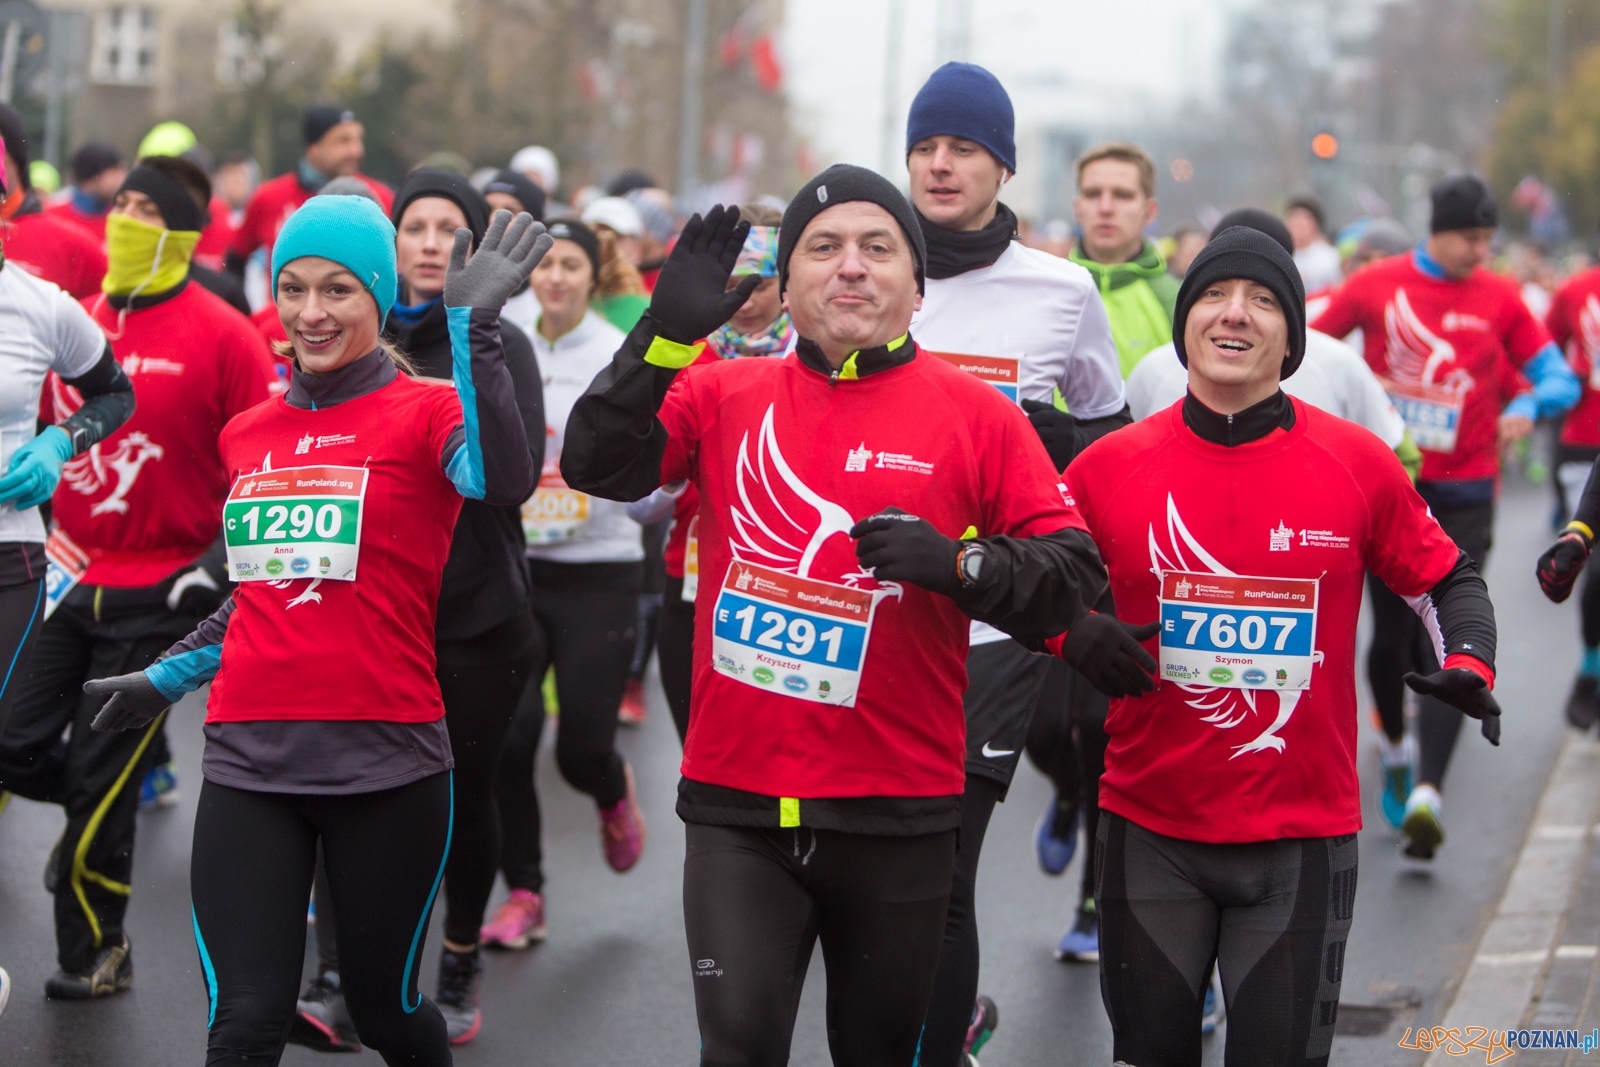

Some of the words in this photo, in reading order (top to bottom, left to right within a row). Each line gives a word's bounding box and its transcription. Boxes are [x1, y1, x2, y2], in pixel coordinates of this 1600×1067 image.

[959, 364, 1011, 377] RunPoland.org
[296, 479, 354, 489] RunPoland.org
[227, 518, 237, 531] C
[242, 503, 342, 541] 1290
[1299, 528, 1308, 546] 1
[273, 547, 294, 555] Anna
[797, 591, 862, 614] RunPoland.org
[1244, 590, 1306, 602] RunPoland.org
[718, 608, 730, 623] E
[1165, 619, 1175, 632] E
[1181, 610, 1298, 651] 7607
[735, 604, 844, 663] 1291
[756, 653, 802, 671] Krzysztof
[1215, 655, 1253, 665] Szymon
[1166, 663, 1188, 672] GRUPA
[1166, 670, 1192, 680] LUXMED
